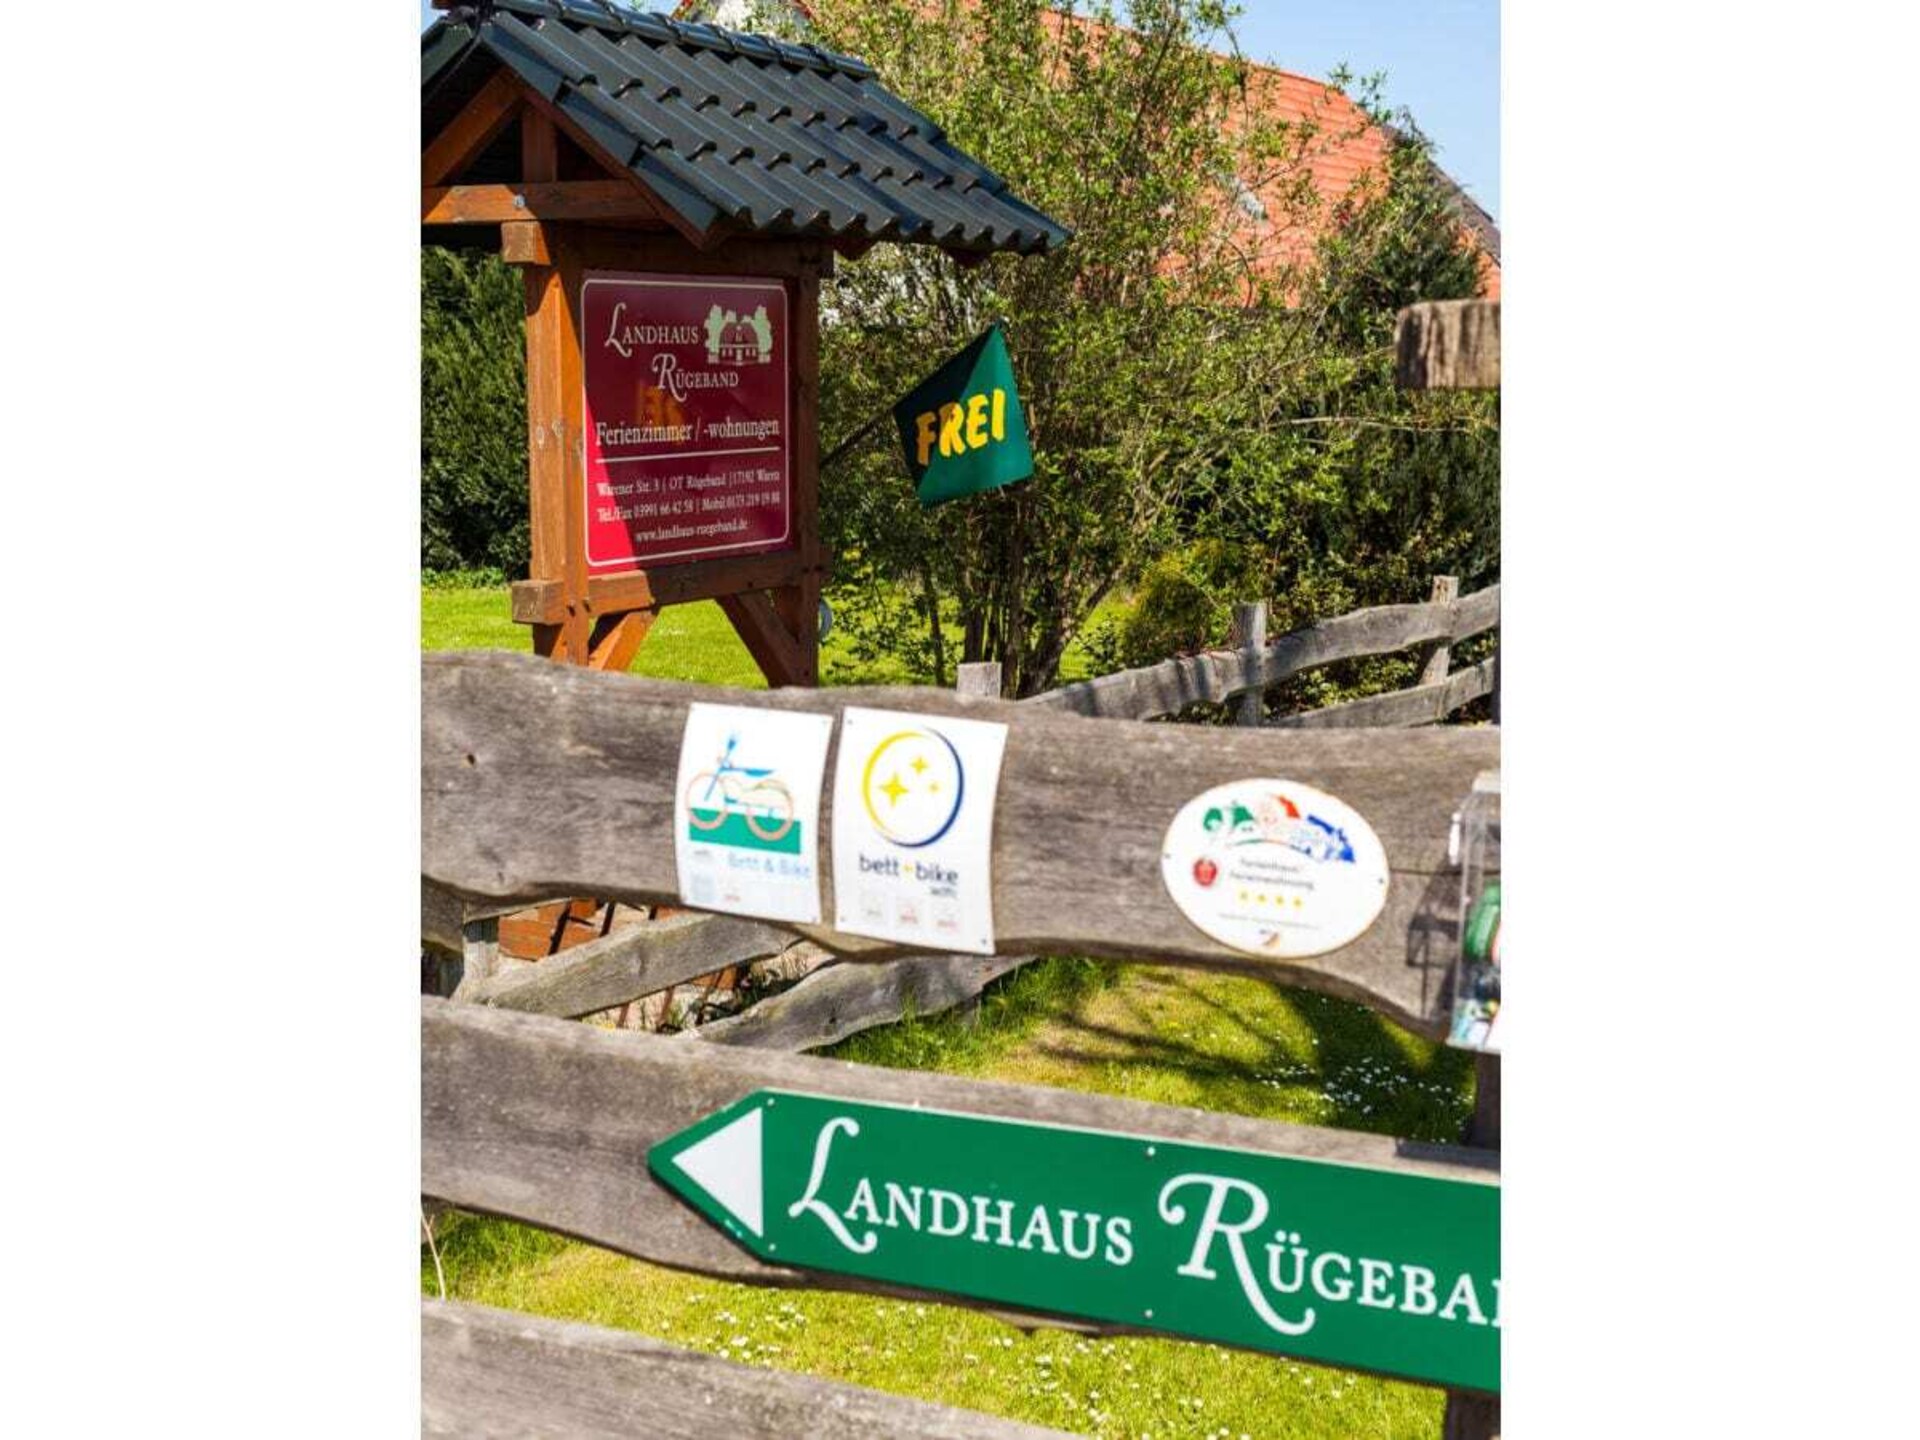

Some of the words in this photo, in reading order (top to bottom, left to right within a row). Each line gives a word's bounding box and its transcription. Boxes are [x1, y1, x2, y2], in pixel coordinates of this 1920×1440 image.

[605, 303, 698, 357] LANDHAUS
[652, 353, 739, 402] RÜGEBAND
[596, 419, 692, 446] Ferienzimmer
[703, 416, 780, 442] -wohnungen
[916, 388, 1006, 466] FREI
[669, 475, 684, 490] OT
[787, 1116, 1134, 1266] LANDHAUS
